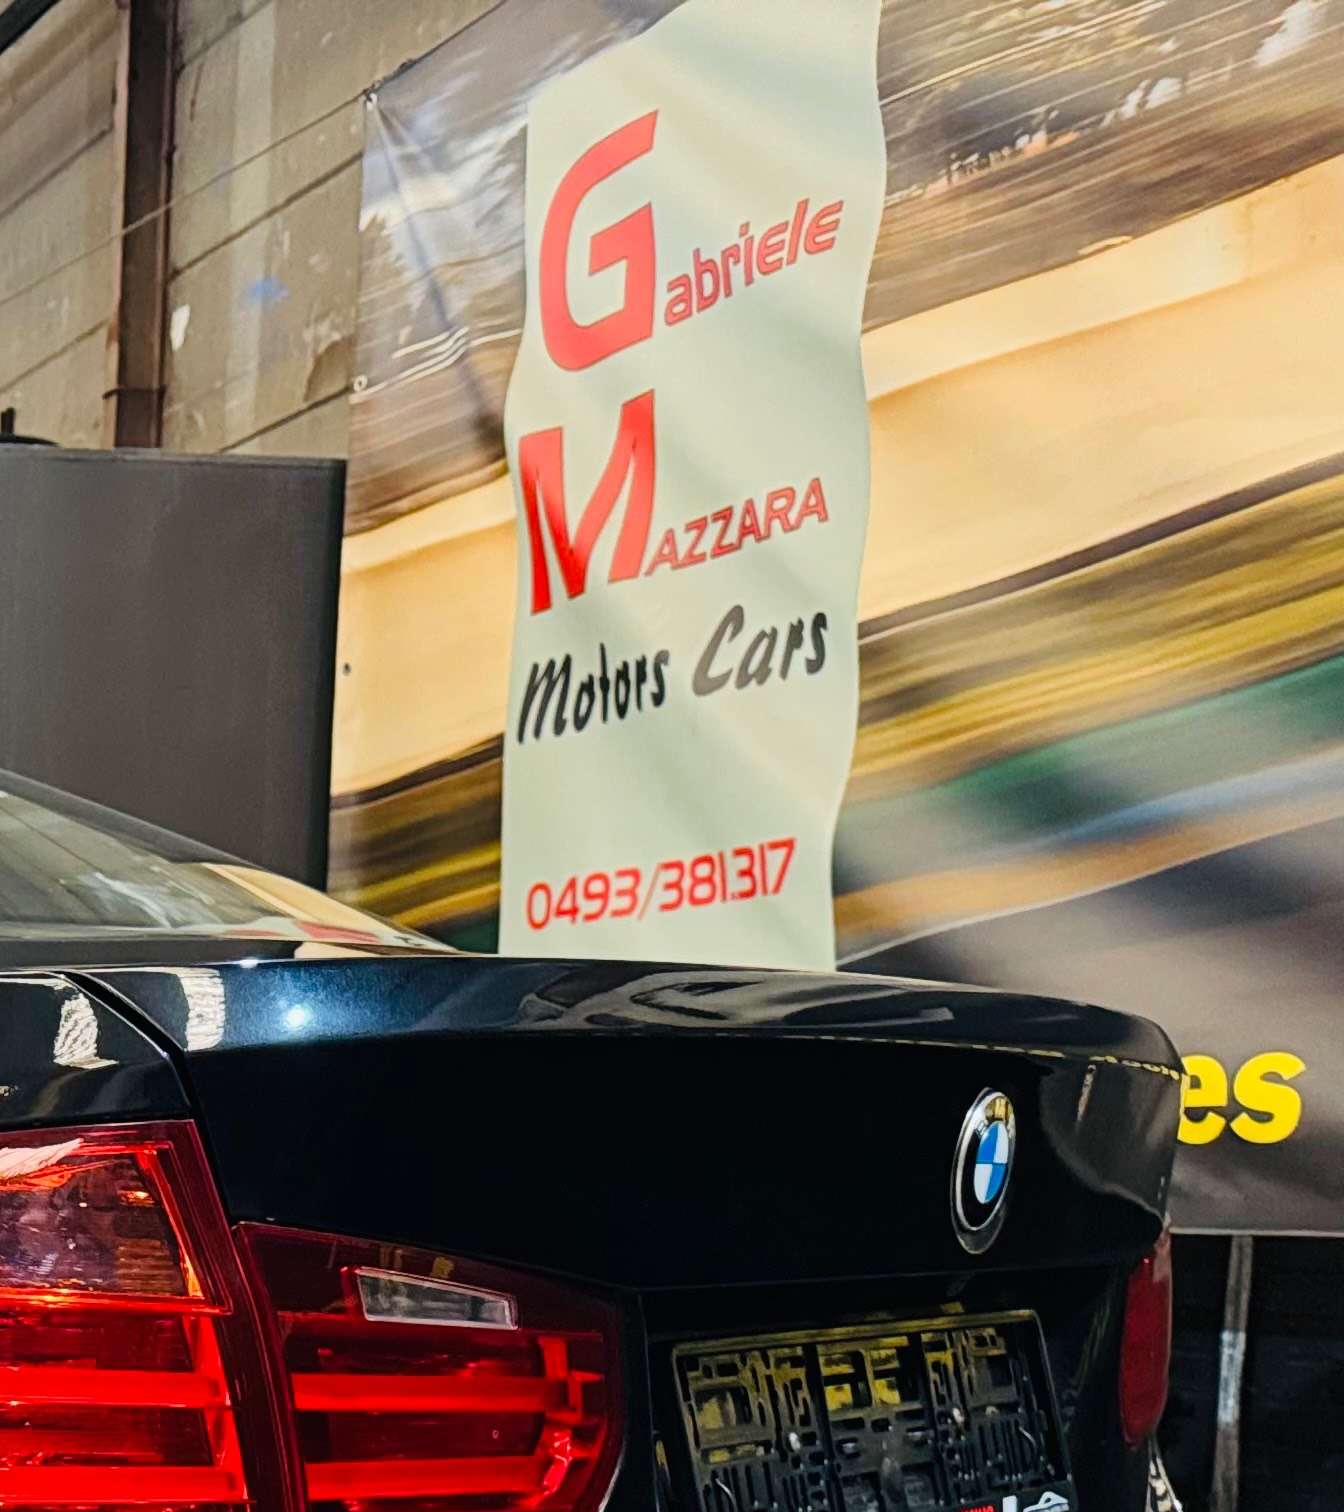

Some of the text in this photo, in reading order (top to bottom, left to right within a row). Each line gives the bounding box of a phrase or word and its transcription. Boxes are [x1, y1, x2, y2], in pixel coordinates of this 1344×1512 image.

[538, 108, 844, 373] Gabriele
[518, 388, 829, 616] MAZZARA
[517, 603, 829, 745] Motors Cars
[1177, 1051, 1306, 1145] es
